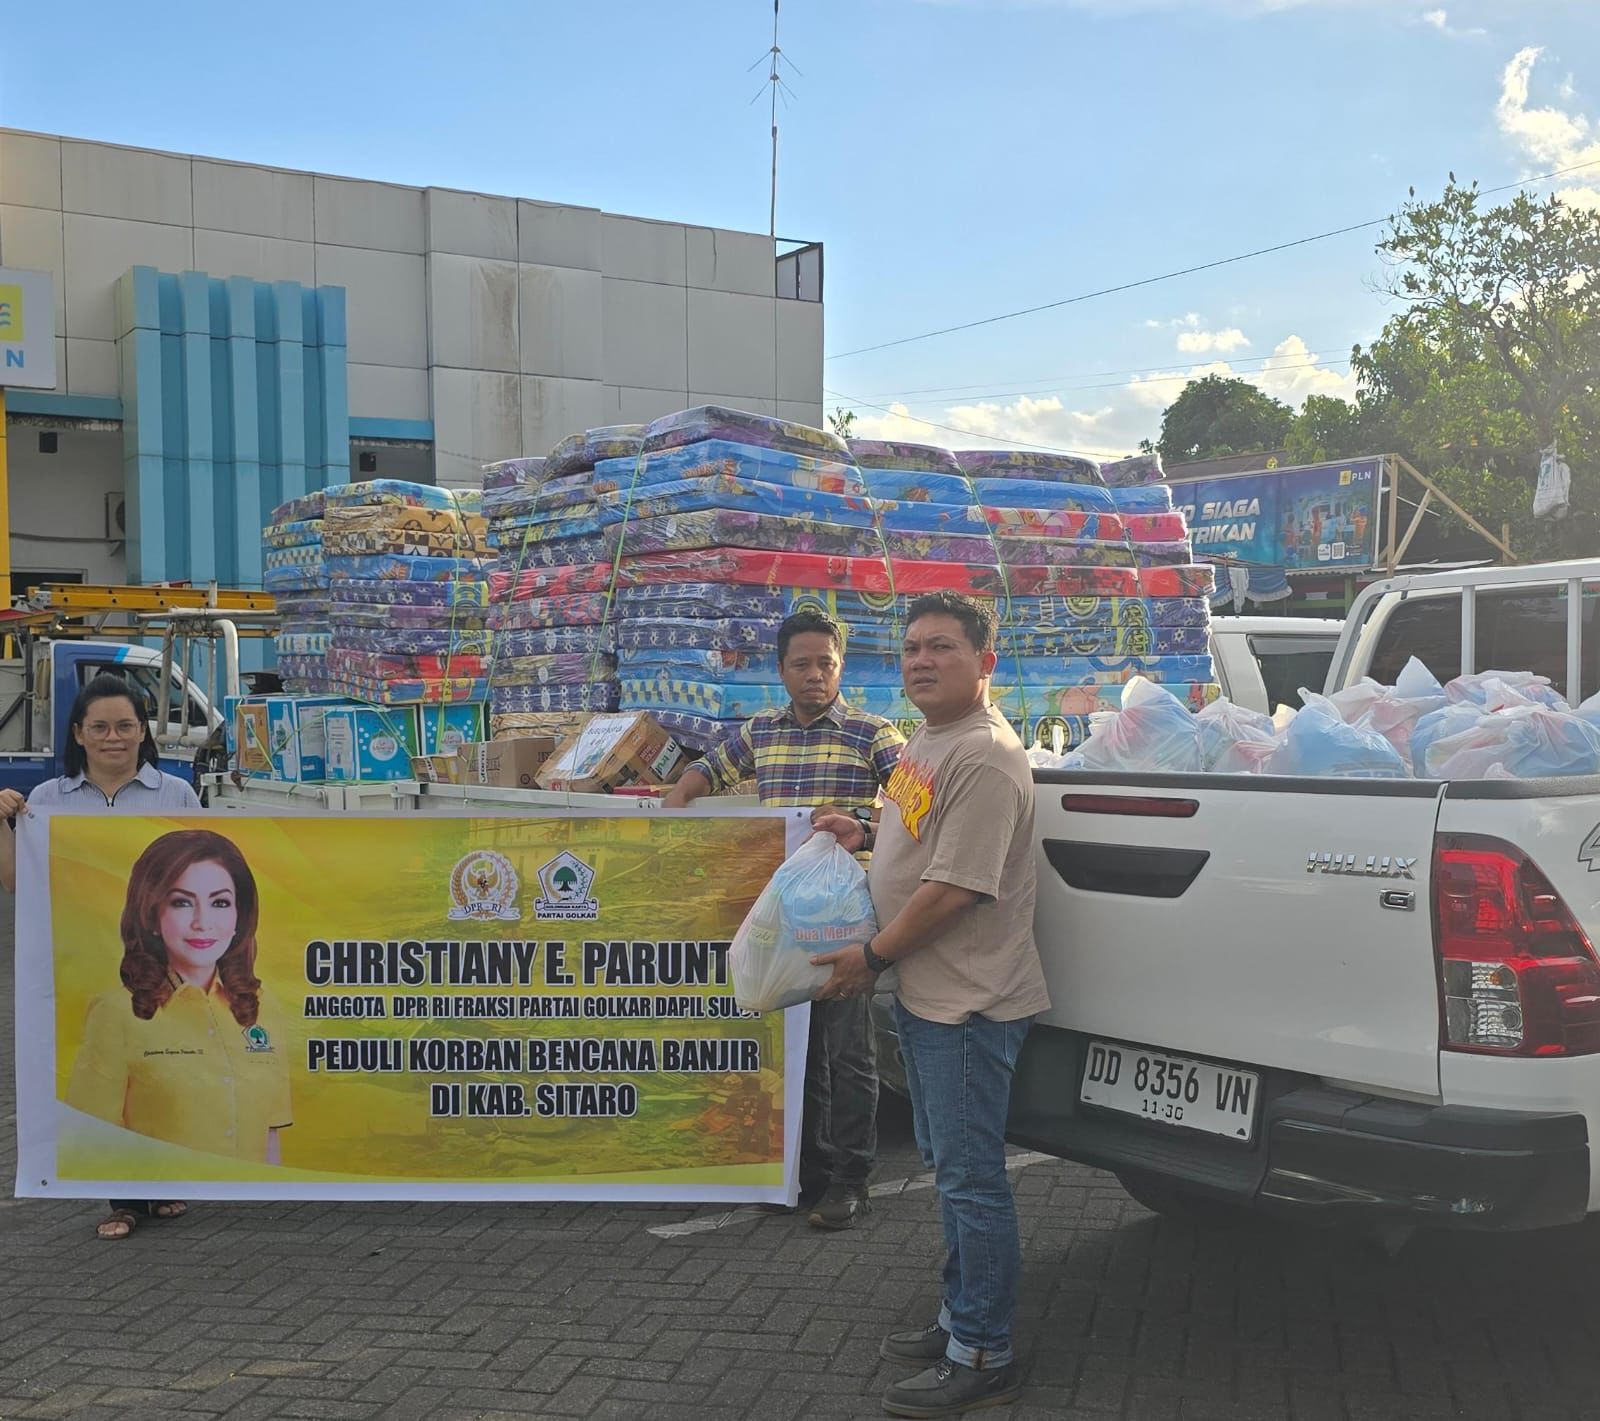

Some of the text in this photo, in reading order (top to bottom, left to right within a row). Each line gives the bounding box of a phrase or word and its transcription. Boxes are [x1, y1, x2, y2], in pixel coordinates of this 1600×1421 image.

[6, 348, 25, 369] N
[1351, 471, 1372, 481] PLN
[1201, 497, 1260, 520] SIAGA
[1187, 522, 1256, 544] TRIKAN
[1577, 821, 1600, 873] 4
[1306, 852, 1418, 880] HILUX
[463, 901, 484, 915] DPR
[795, 927, 819, 941] Dua
[306, 941, 733, 985] CHRISTIANY E. PARUNT
[304, 996, 759, 1017] ANGGOTA DPR RI FRAKSI PARTAI GOLKAR DAPIL SUL
[308, 1039, 759, 1071] PEDULI KORBAN BENCANA BANJIR
[1088, 1047, 1252, 1115] DD 8356 VN
[432, 1084, 636, 1115] DI KAB. SITARO
